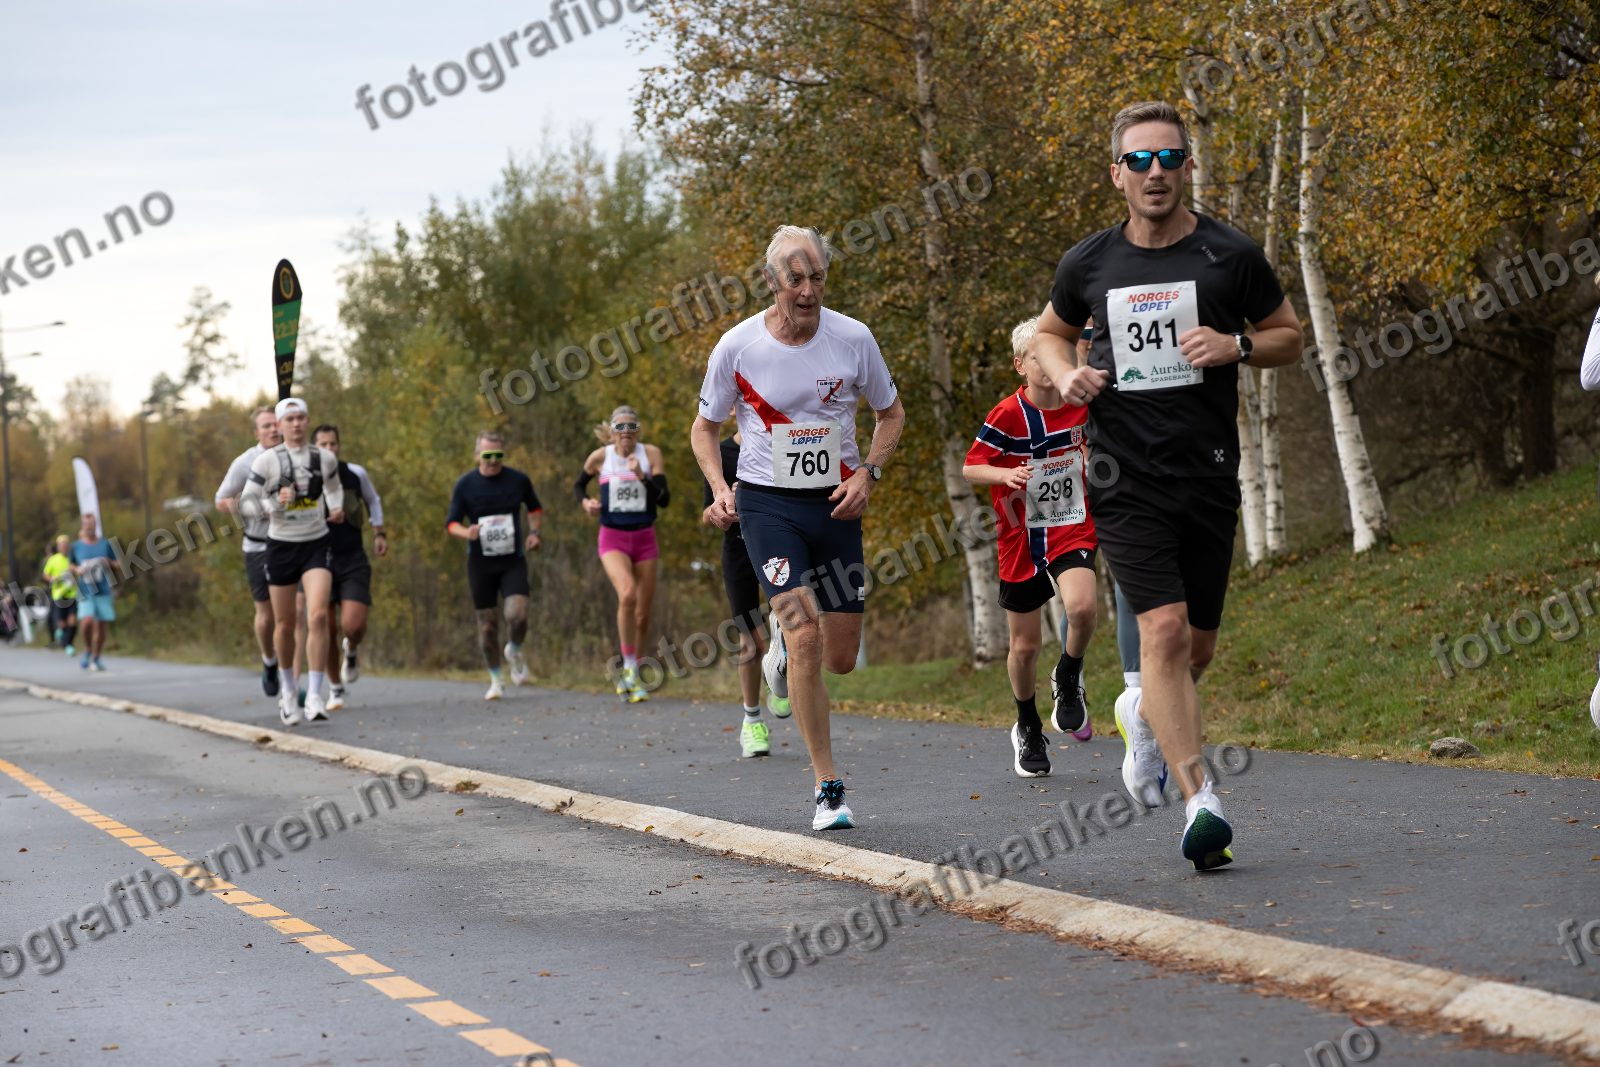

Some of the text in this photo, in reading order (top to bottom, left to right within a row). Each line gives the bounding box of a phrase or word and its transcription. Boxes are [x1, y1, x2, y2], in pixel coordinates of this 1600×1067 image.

[1127, 290, 1180, 303] NORGES
[1132, 301, 1172, 313] LØPET
[1127, 318, 1178, 353] 341
[788, 428, 830, 438] NORGES
[792, 436, 824, 445] LØPET
[786, 449, 830, 477] 760
[1041, 458, 1074, 470] NORGES
[1044, 466, 1069, 476] LØPET
[616, 487, 639, 501] 894
[1038, 477, 1073, 502] 298
